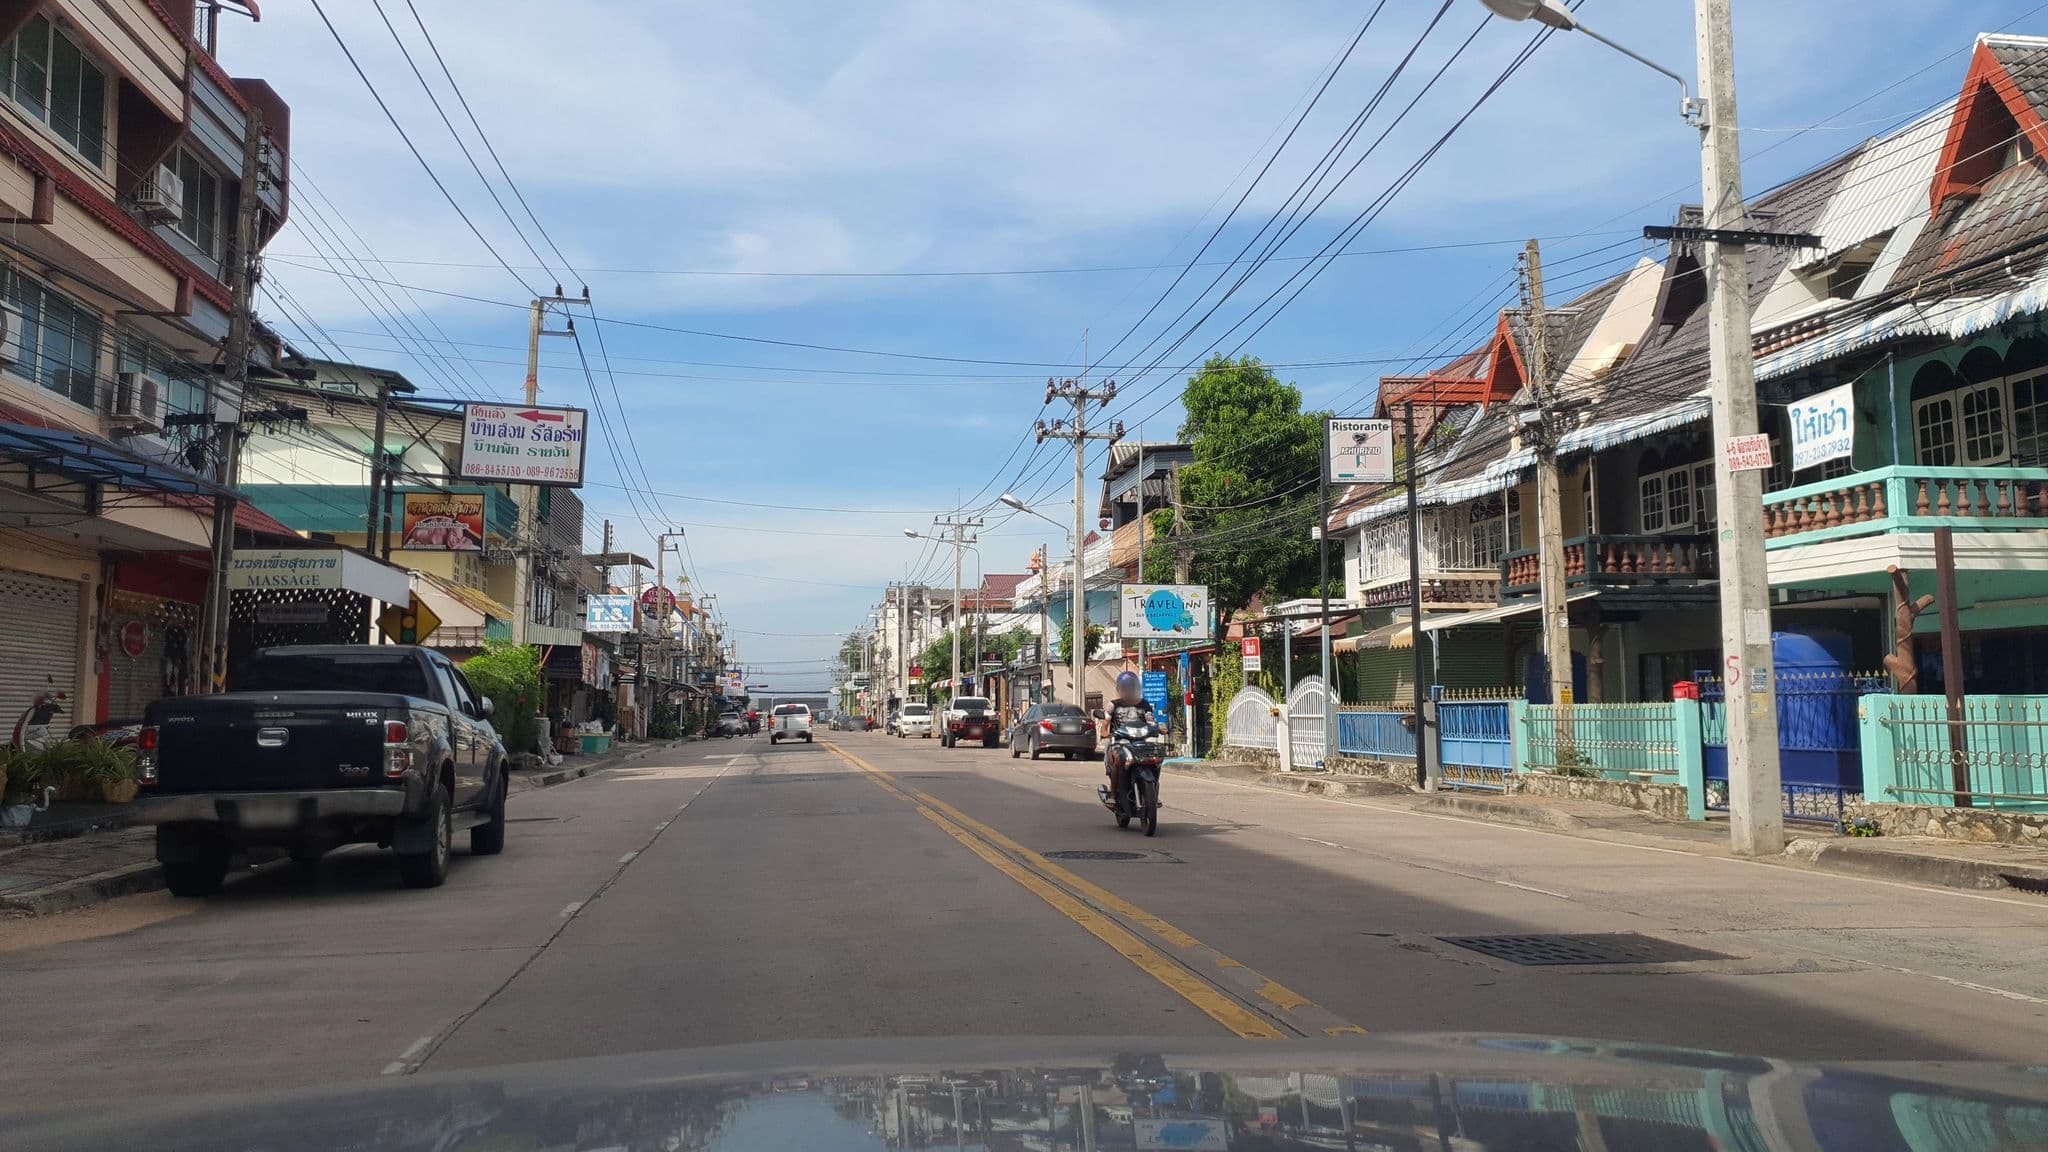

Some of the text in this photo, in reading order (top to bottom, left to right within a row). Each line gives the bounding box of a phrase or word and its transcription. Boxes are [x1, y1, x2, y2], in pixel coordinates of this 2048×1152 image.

[1332, 421, 1389, 431] Ristorante
[1792, 400, 1847, 445] ให้เช่า
[234, 552, 337, 574] นวดเพื่อสุขภาพ
[248, 575, 321, 586] MASSAGE
[1128, 595, 1177, 610] TRAVEL
